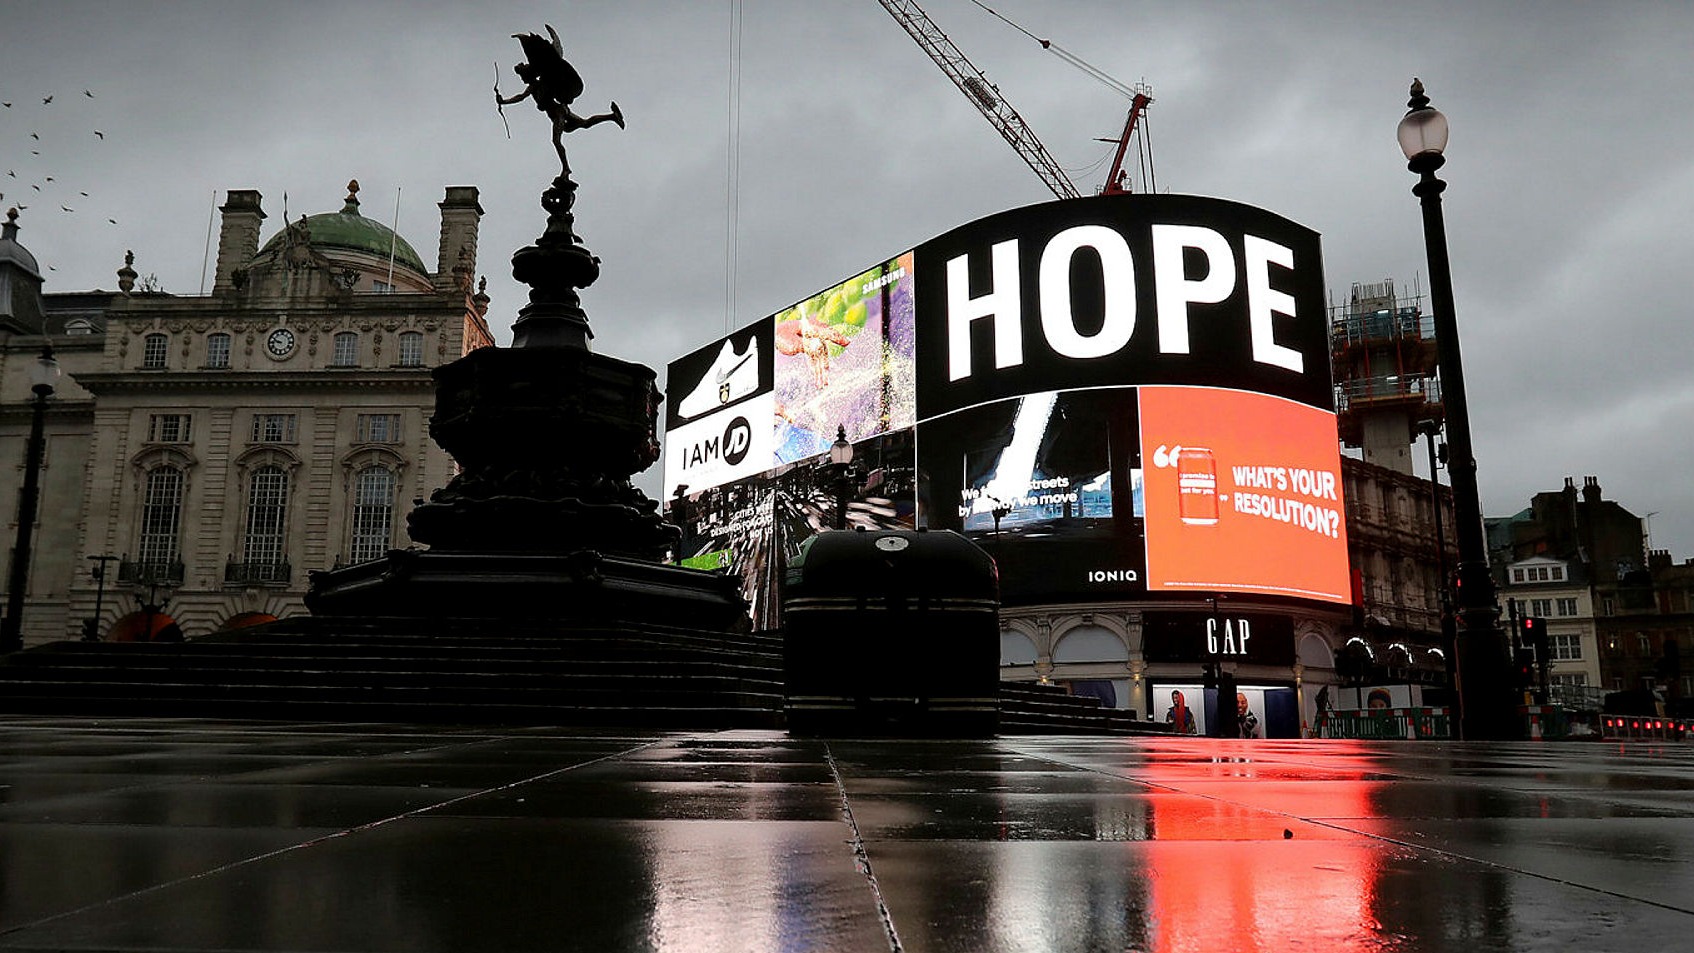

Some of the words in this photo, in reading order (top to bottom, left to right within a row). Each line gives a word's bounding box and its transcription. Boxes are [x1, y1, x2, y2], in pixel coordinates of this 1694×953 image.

[862, 267, 905, 295] SAMSUNG
[946, 224, 1303, 382] HOPE
[683, 448, 687, 470] I
[690, 436, 719, 468] AM
[724, 422, 750, 460] JD
[961, 488, 980, 500] We
[1232, 466, 1287, 491] WHAT'S
[1288, 468, 1337, 500] YOUR
[958, 505, 972, 518] by
[1040, 493, 1077, 505] move
[1234, 492, 1339, 538] RESOLUTION?
[1088, 570, 1137, 583] IONIQ
[1206, 618, 1250, 655] GAP
